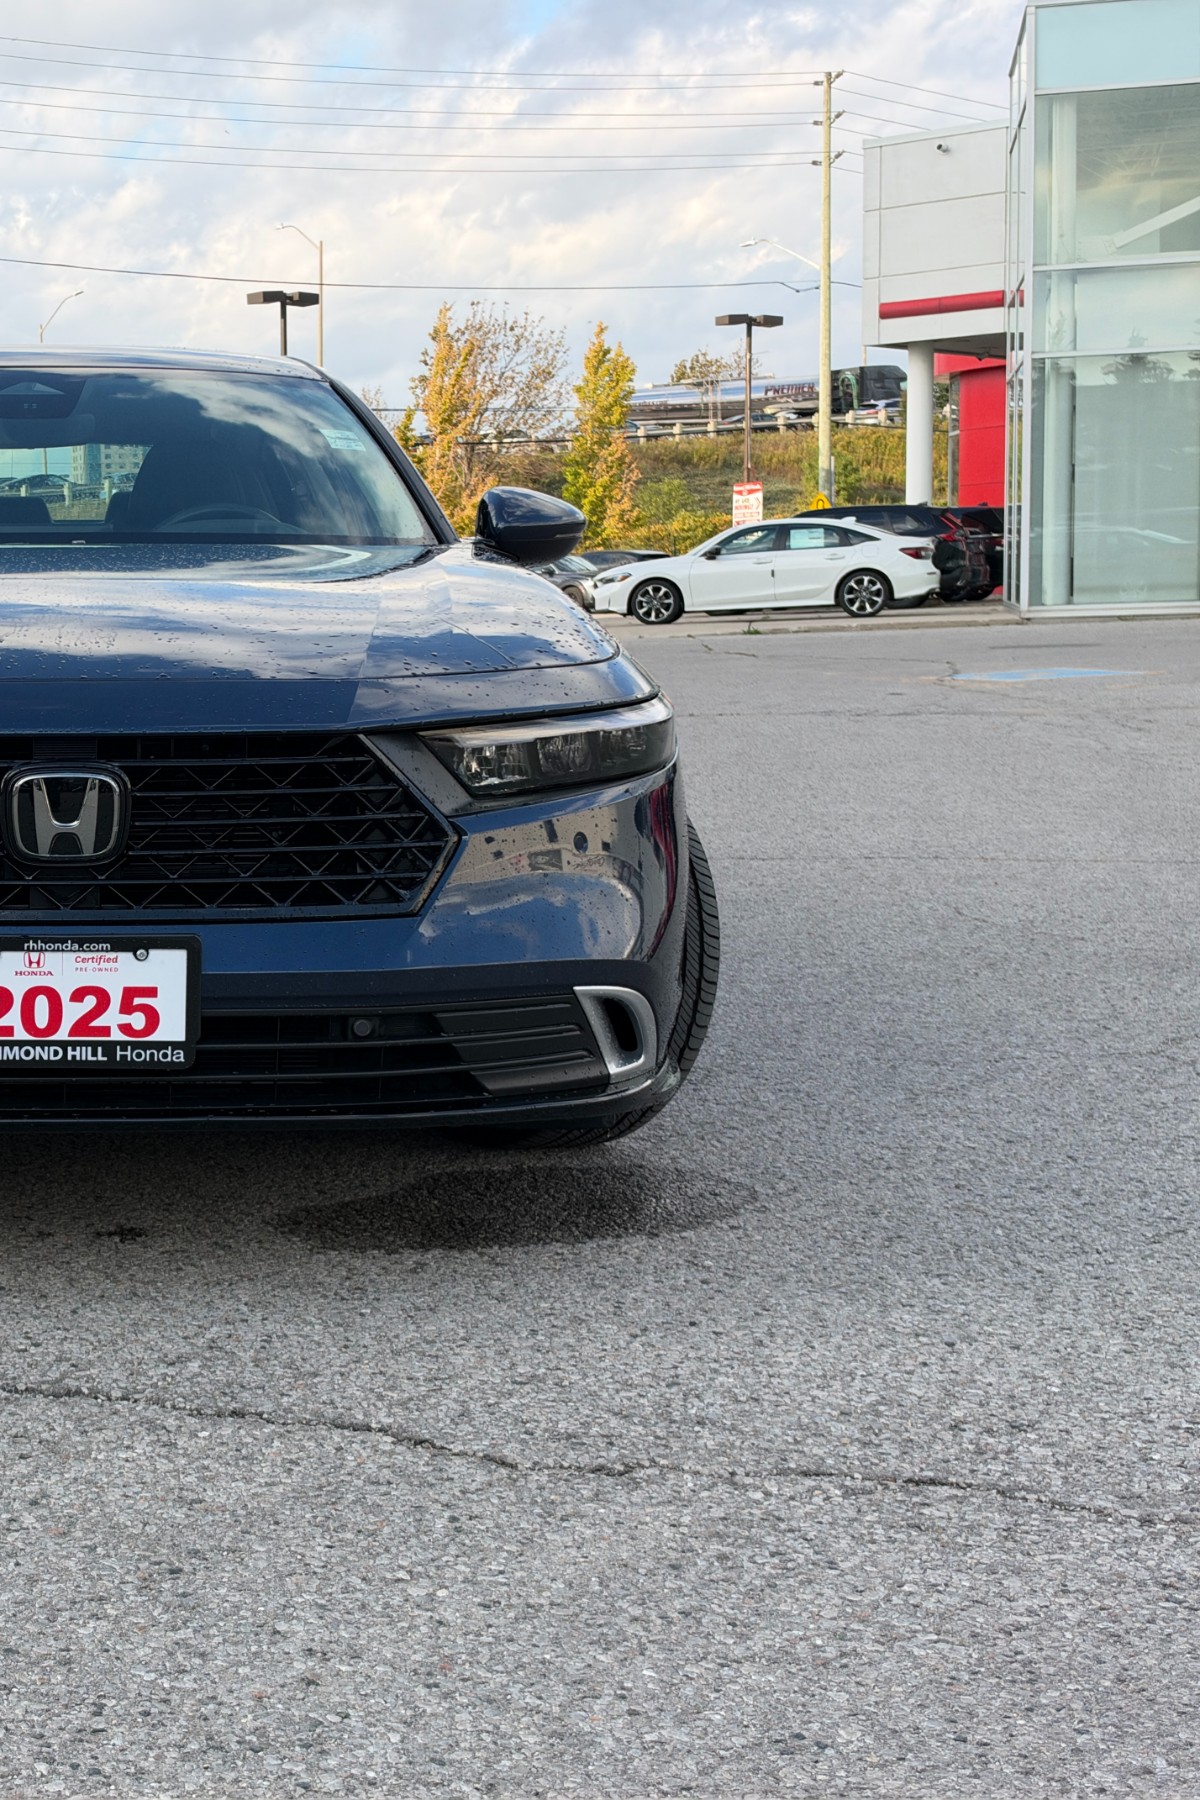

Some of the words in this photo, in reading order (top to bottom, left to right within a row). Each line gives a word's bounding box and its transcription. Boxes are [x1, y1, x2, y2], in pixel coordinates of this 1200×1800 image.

[24, 939, 111, 951] rhhonda.com
[74, 955, 119, 966] Certified
[67, 1046, 108, 1061] HILL
[116, 1045, 186, 1063] Honda
